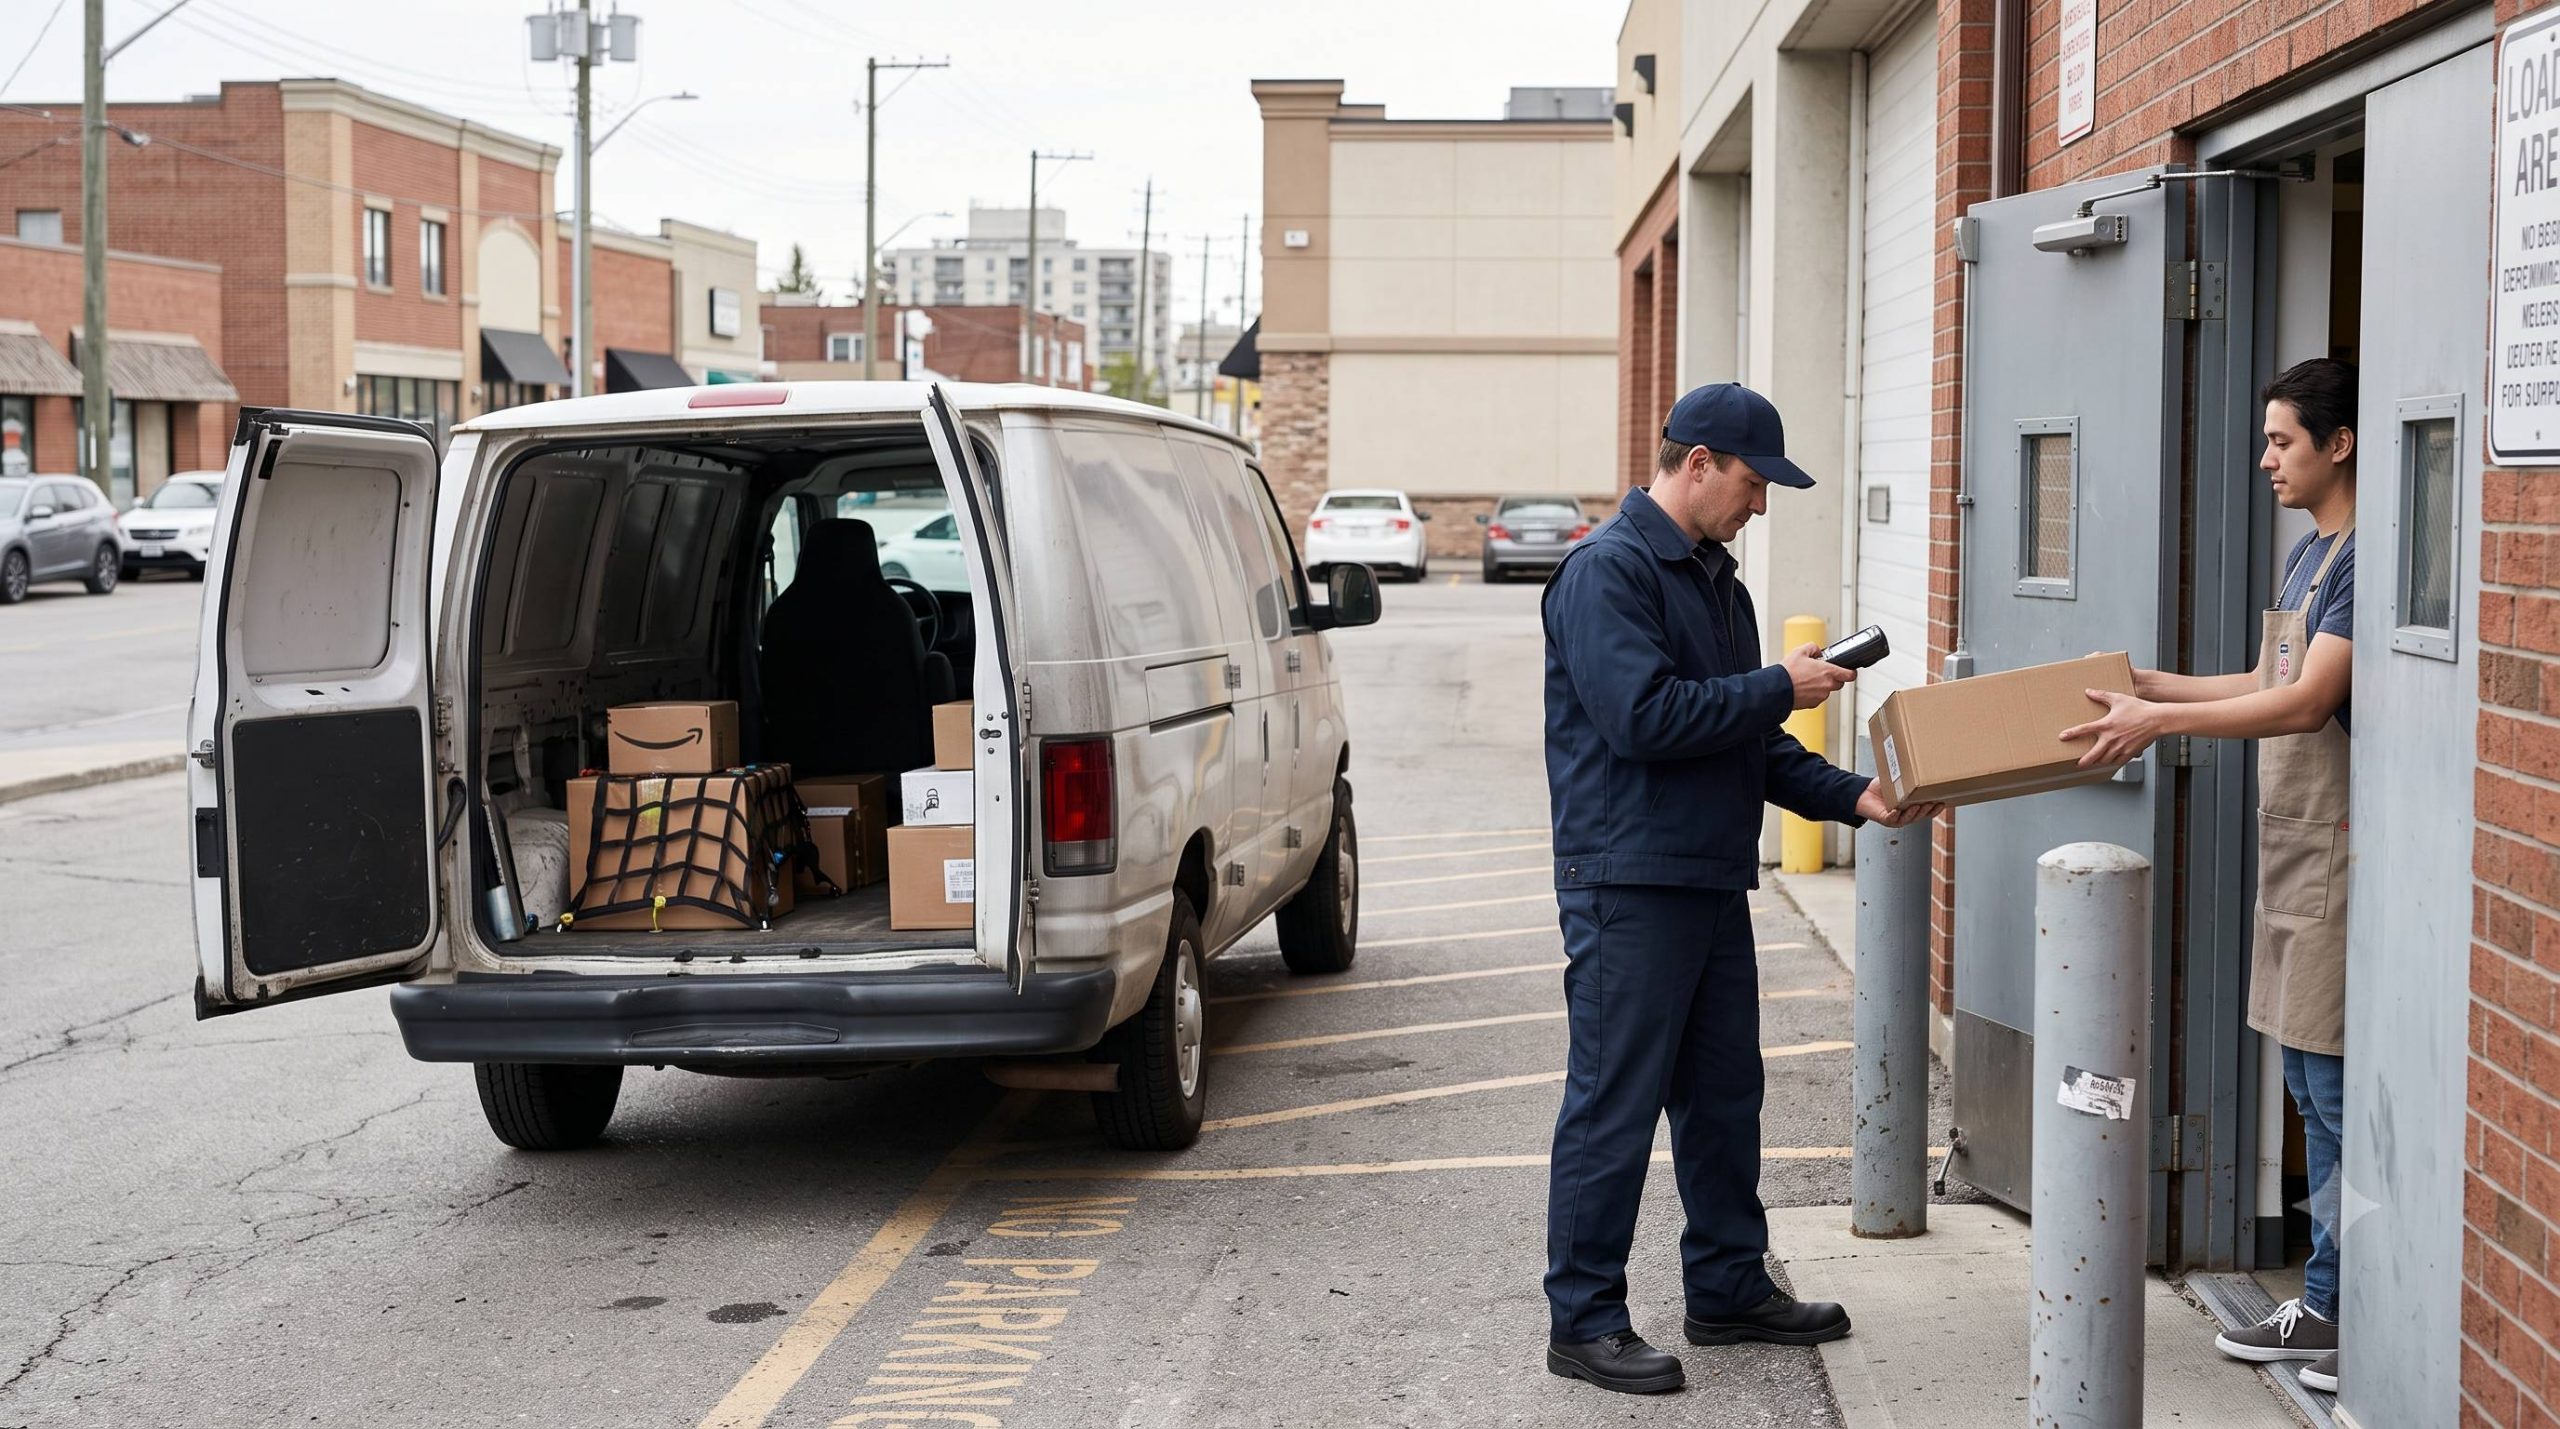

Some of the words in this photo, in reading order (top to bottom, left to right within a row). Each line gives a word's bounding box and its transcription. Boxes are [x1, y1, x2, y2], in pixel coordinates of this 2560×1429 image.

[2521, 224, 2535, 251] NO
[2502, 384, 2522, 408] FOR
[987, 1196, 1138, 1238] NO
